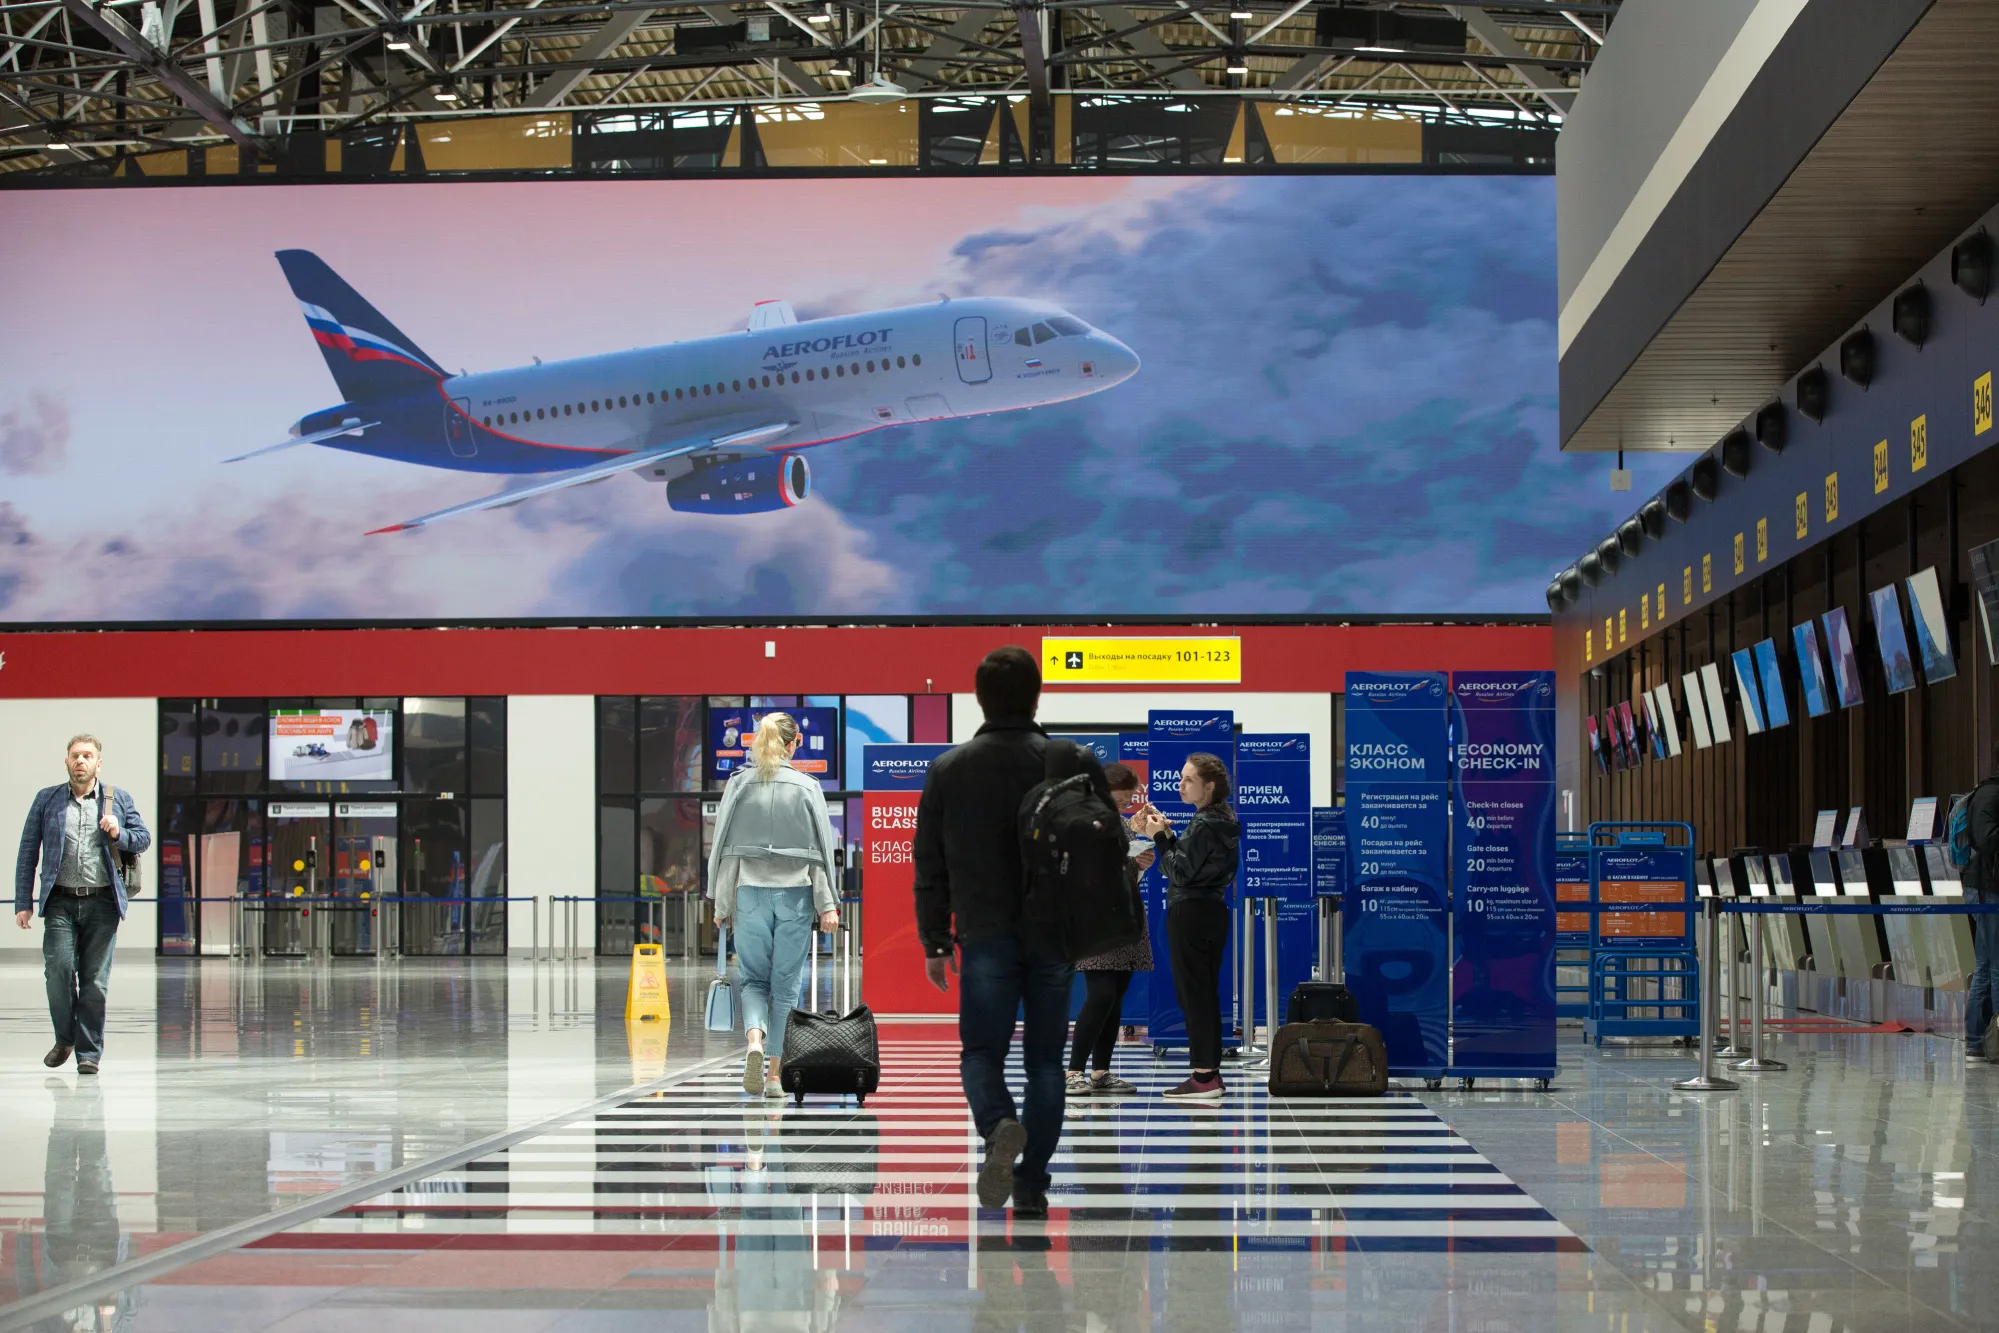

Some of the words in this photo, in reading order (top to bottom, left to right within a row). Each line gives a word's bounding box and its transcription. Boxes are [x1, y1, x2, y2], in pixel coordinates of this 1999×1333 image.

[762, 328, 893, 360] AEROFLOT
[1976, 382, 1990, 425] 346
[1912, 424, 1924, 463] 345
[1875, 448, 1887, 485] 344
[1826, 481, 1836, 514] 343
[1796, 500, 1806, 532] 342
[1175, 651, 1230, 662] 101-123
[1350, 744, 1408, 755] КЛАСС
[1458, 744, 1544, 755] ECONOMY
[1350, 758, 1425, 769] ЭКОНОМ
[1458, 758, 1540, 769] CHECK-IN
[1153, 770, 1182, 779] КЛА
[1153, 782, 1180, 791] ЭКО
[1239, 786, 1282, 794] ПРИЕМ
[1239, 796, 1290, 804] БАГАЖА
[1361, 793, 1408, 801] Регистрация
[1421, 793, 1439, 801] рейс
[872, 806, 918, 817] BUSIN
[872, 818, 918, 828] CLASS
[1361, 816, 1379, 828] 40
[1467, 817, 1485, 829] 40
[872, 841, 914, 852] КЛАС
[872, 853, 914, 863] БИЗН
[1361, 862, 1379, 874] 20
[1467, 859, 1485, 872] 20
[1247, 877, 1260, 886] 23
[1392, 885, 1418, 893] кабину
[1467, 885, 1499, 894] Carry-on
[1500, 885, 1530, 894] luggage
[1361, 899, 1378, 911] 10
[1467, 900, 1484, 912] 10
